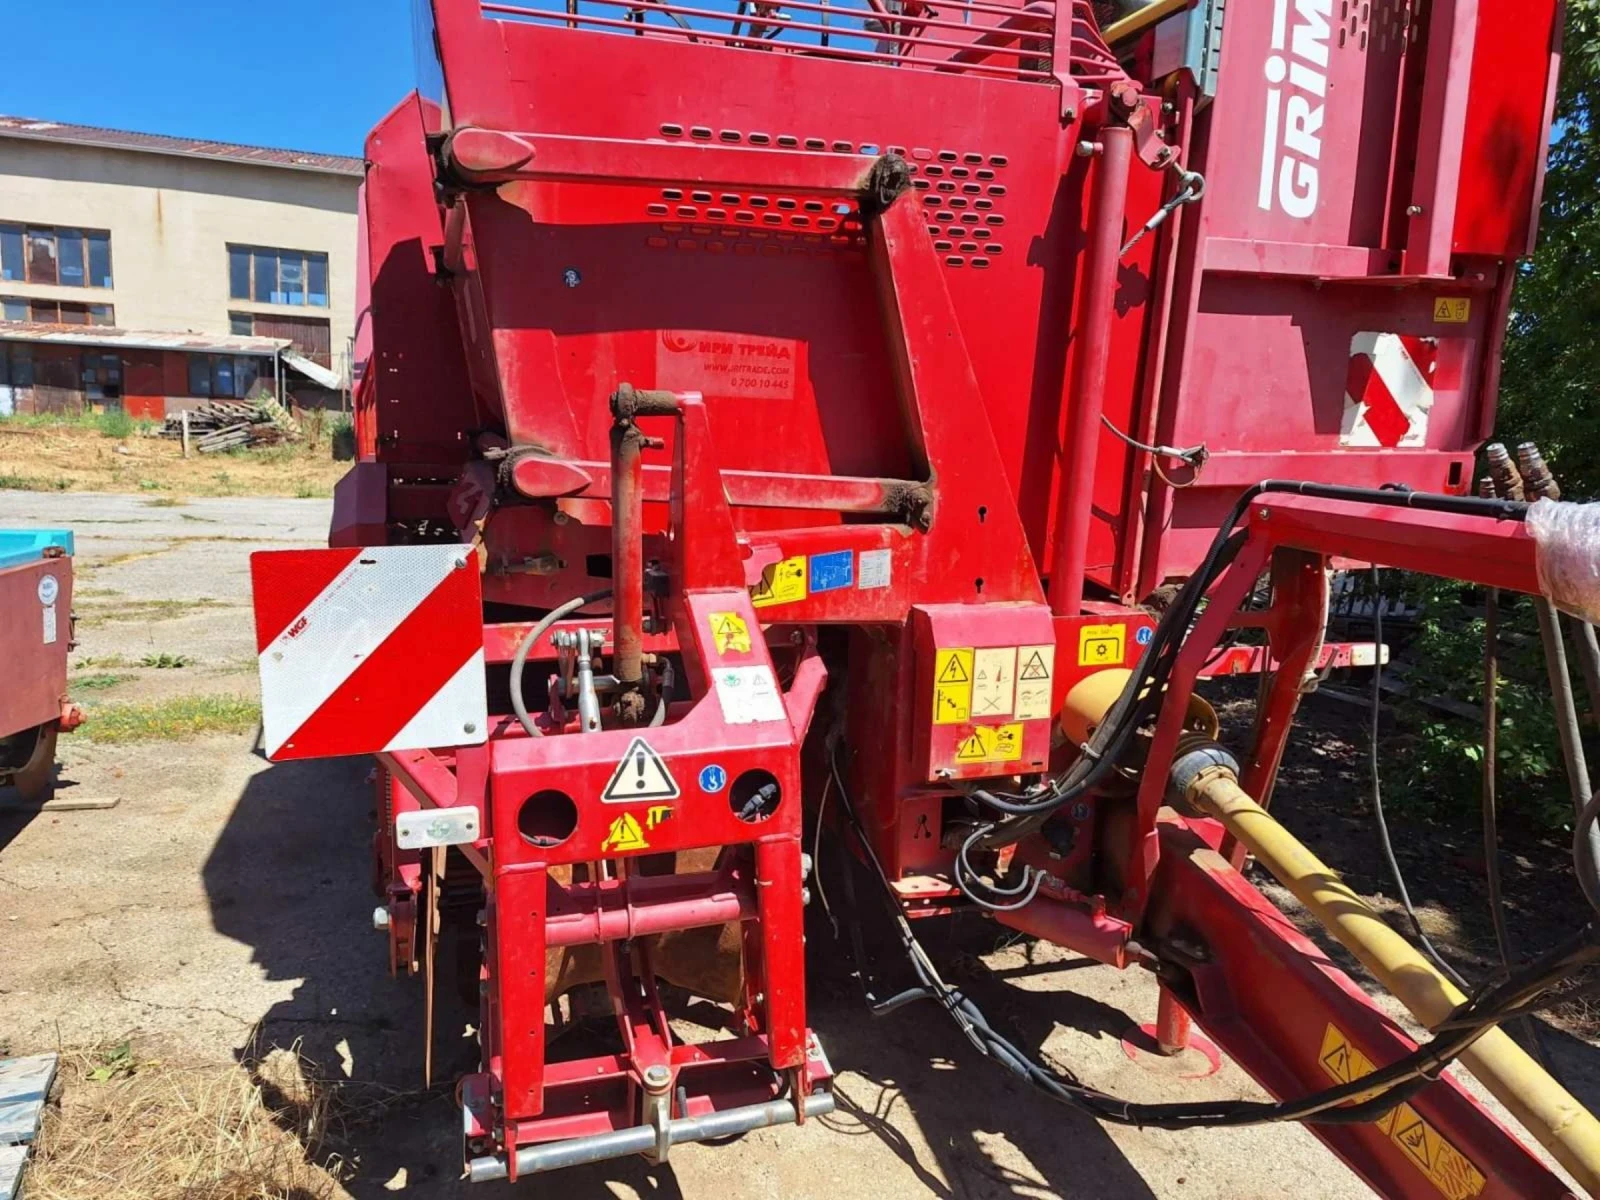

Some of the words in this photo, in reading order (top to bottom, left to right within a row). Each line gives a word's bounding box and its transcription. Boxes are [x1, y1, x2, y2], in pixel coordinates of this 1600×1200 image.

[699, 342, 733, 354] ИРИ
[738, 343, 790, 359] ТРЕЙД
[739, 378, 757, 388] 700
[759, 379, 770, 389] 10
[288, 616, 308, 638] WGF
